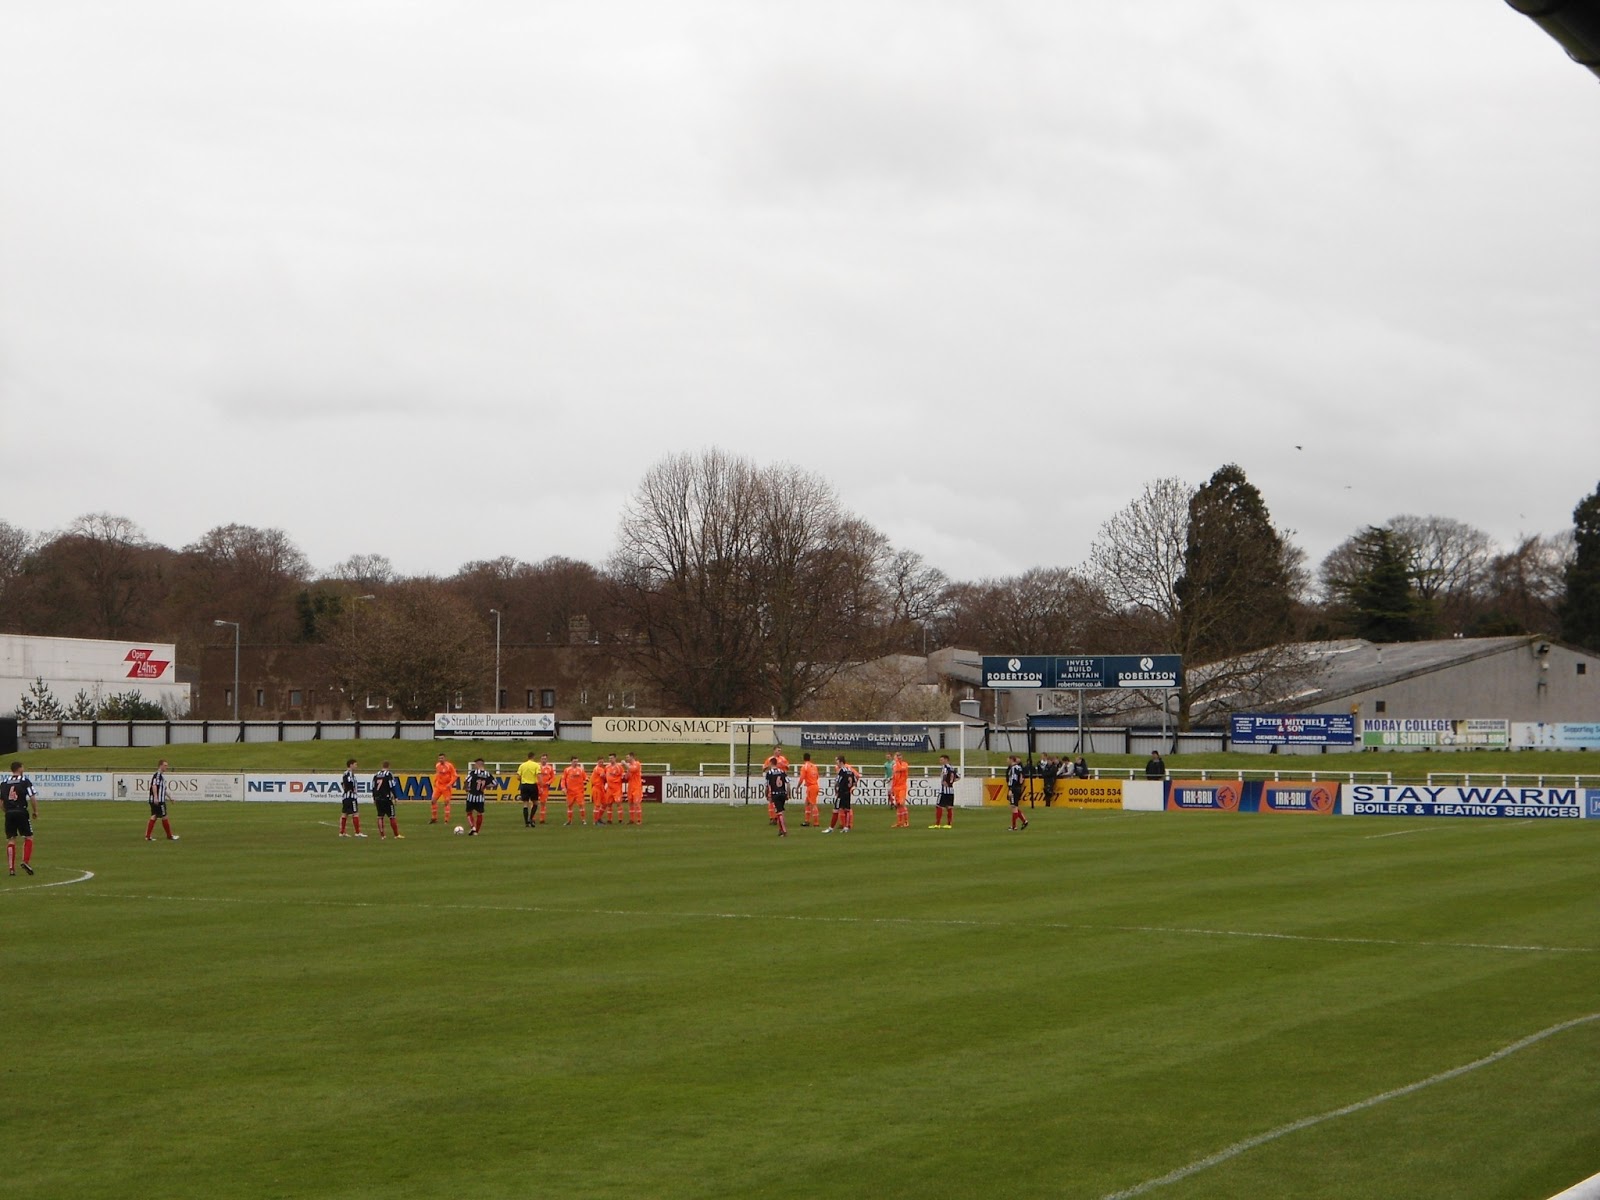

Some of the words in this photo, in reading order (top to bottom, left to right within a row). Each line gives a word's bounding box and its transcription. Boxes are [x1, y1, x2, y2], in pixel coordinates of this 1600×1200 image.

[131, 650, 146, 660] Open
[136, 661, 157, 674] 24hrs
[1118, 672, 1176, 680] ROBERTSON
[1057, 680, 1102, 688] robertson.co.uk
[451, 715, 485, 727] Strathdee
[486, 715, 537, 731] Properties.com
[1255, 717, 1282, 727] PETER
[1284, 717, 1327, 728] MITCHELL
[1364, 720, 1402, 731] MORAY
[1405, 720, 1450, 731] COLLEGE
[803, 731, 828, 741] GLEN
[829, 732, 860, 742] MORAY
[867, 732, 892, 742] GLEN
[892, 733, 926, 743] MORAY
[1382, 732, 1398, 745] ON
[1400, 732, 1437, 745] SIDE!!!
[34, 774, 81, 782] PLUMBERS
[85, 774, 103, 782] LTD
[776, 775, 783, 788] 6
[136, 778, 198, 792] RIONS
[247, 781, 287, 793] NET
[289, 781, 373, 793] DATAEL
[376, 779, 383, 791] 7
[910, 779, 932, 789] F.C.
[8, 785, 18, 800] 4
[1068, 788, 1088, 796] 0800
[1090, 788, 1105, 796] 833
[1107, 788, 1122, 796] 534
[1352, 785, 1448, 803] STAY
[1457, 787, 1577, 805] WARM
[1354, 803, 1409, 815] BOILER
[1414, 804, 1425, 815] &
[1433, 804, 1499, 817] HEATING
[1503, 806, 1580, 819] SERVICES
